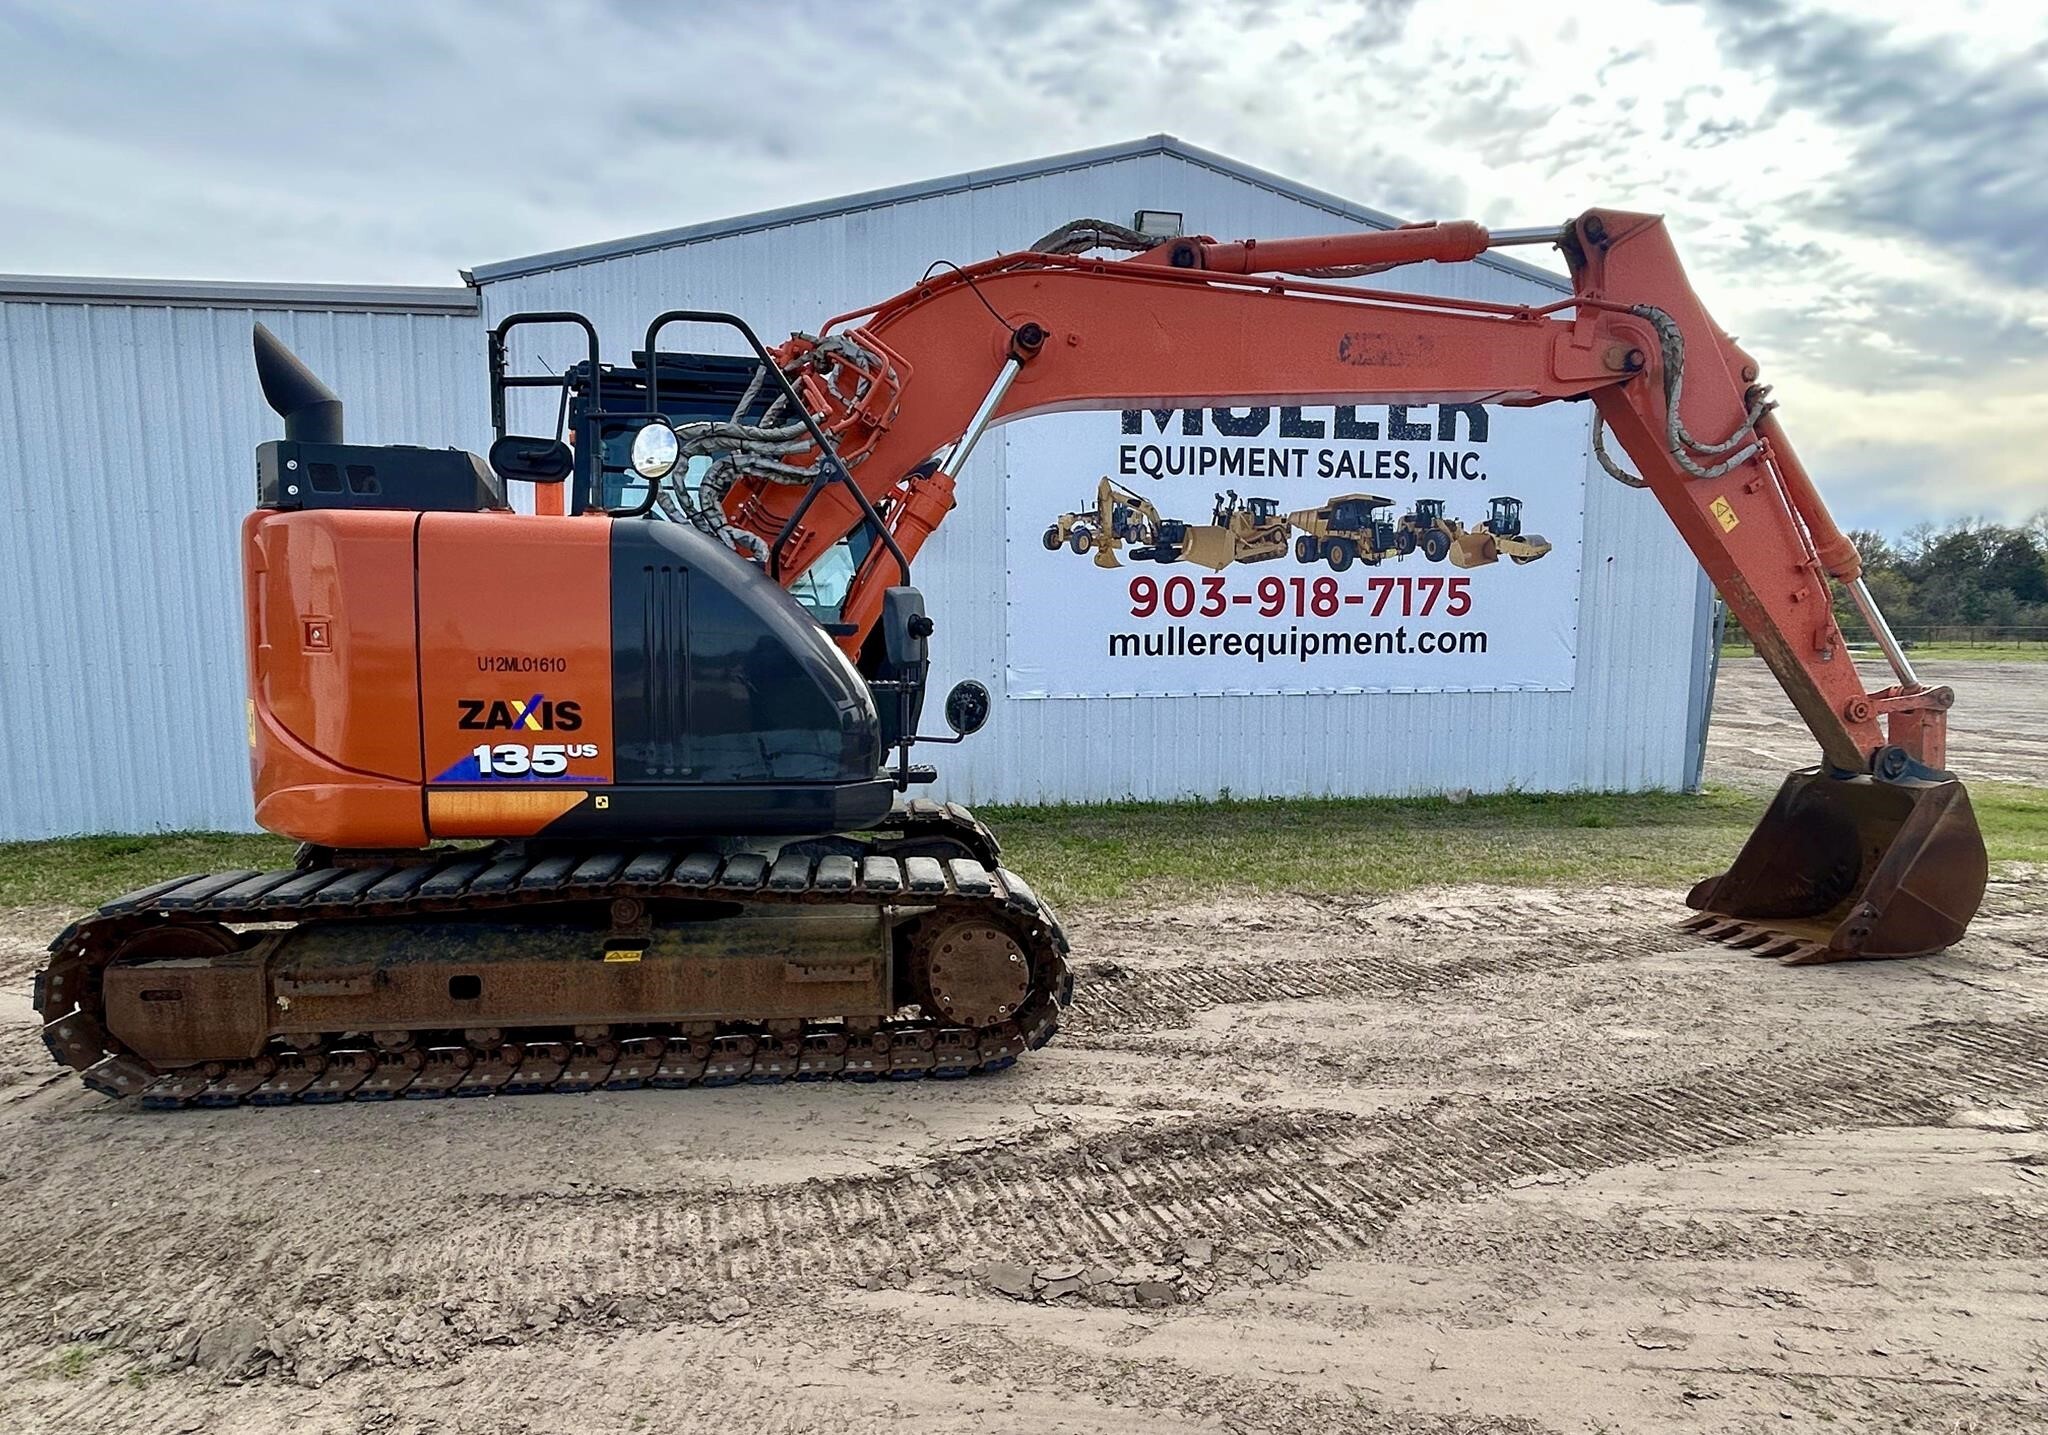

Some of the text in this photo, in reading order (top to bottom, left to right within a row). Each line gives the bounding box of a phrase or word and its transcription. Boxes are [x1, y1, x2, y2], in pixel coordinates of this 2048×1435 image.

[1120, 444, 1487, 483] EQUIPMENT SALES, INC.
[1129, 576, 1472, 618] 903-918-7175
[1109, 626, 1488, 662] mullerequipment.com
[458, 693, 583, 732] ZAXIS
